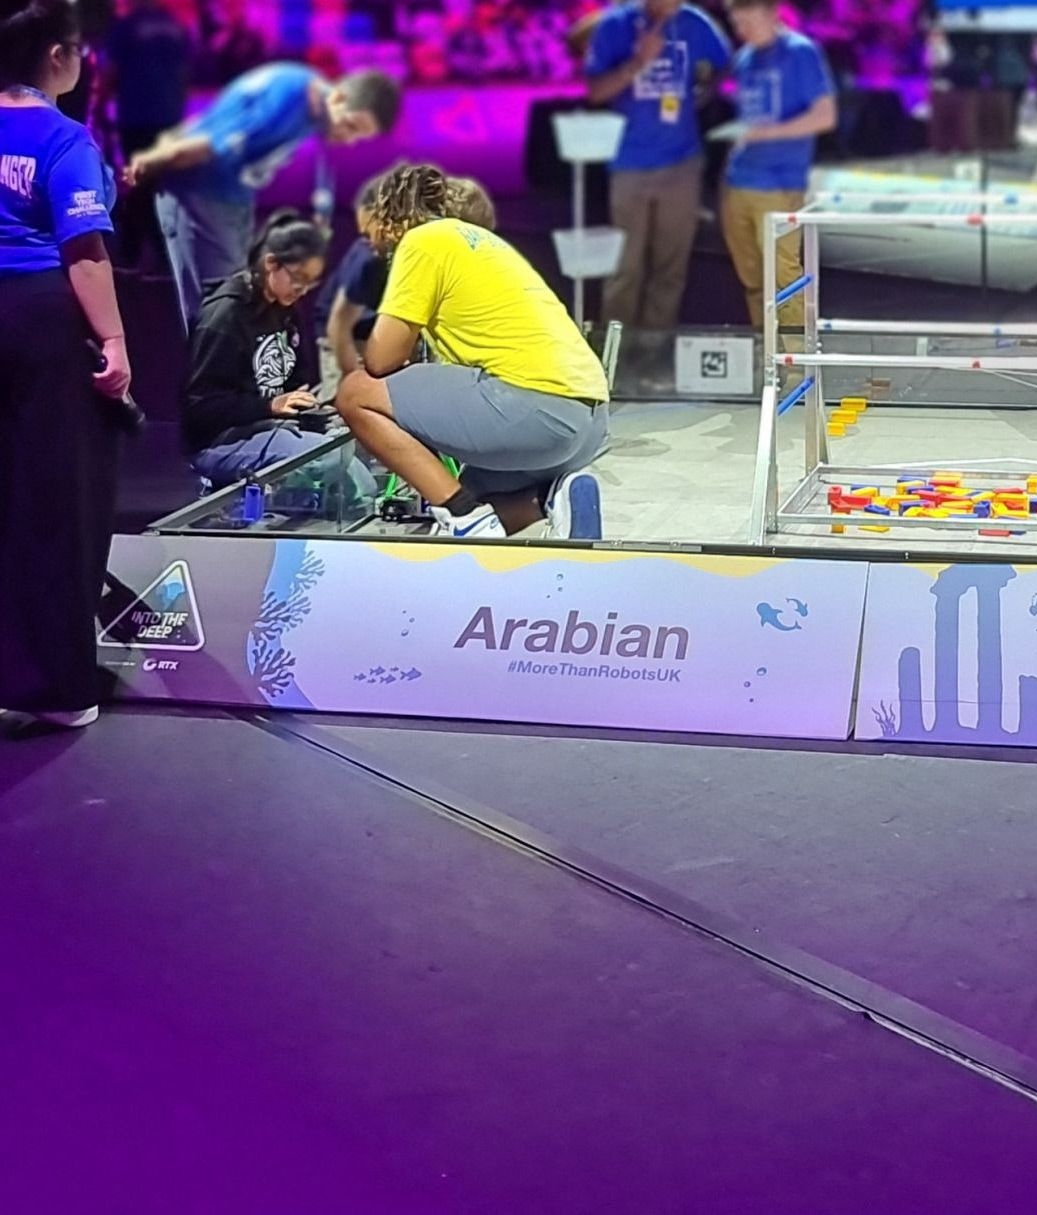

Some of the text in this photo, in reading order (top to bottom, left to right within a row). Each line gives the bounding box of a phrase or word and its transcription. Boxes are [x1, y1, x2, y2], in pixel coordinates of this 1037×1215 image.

[131, 611, 188, 627] INTO THE
[137, 625, 173, 638] DEEP
[454, 605, 689, 661] Arabian
[507, 661, 681, 682] #MoreThanRobotsUK
